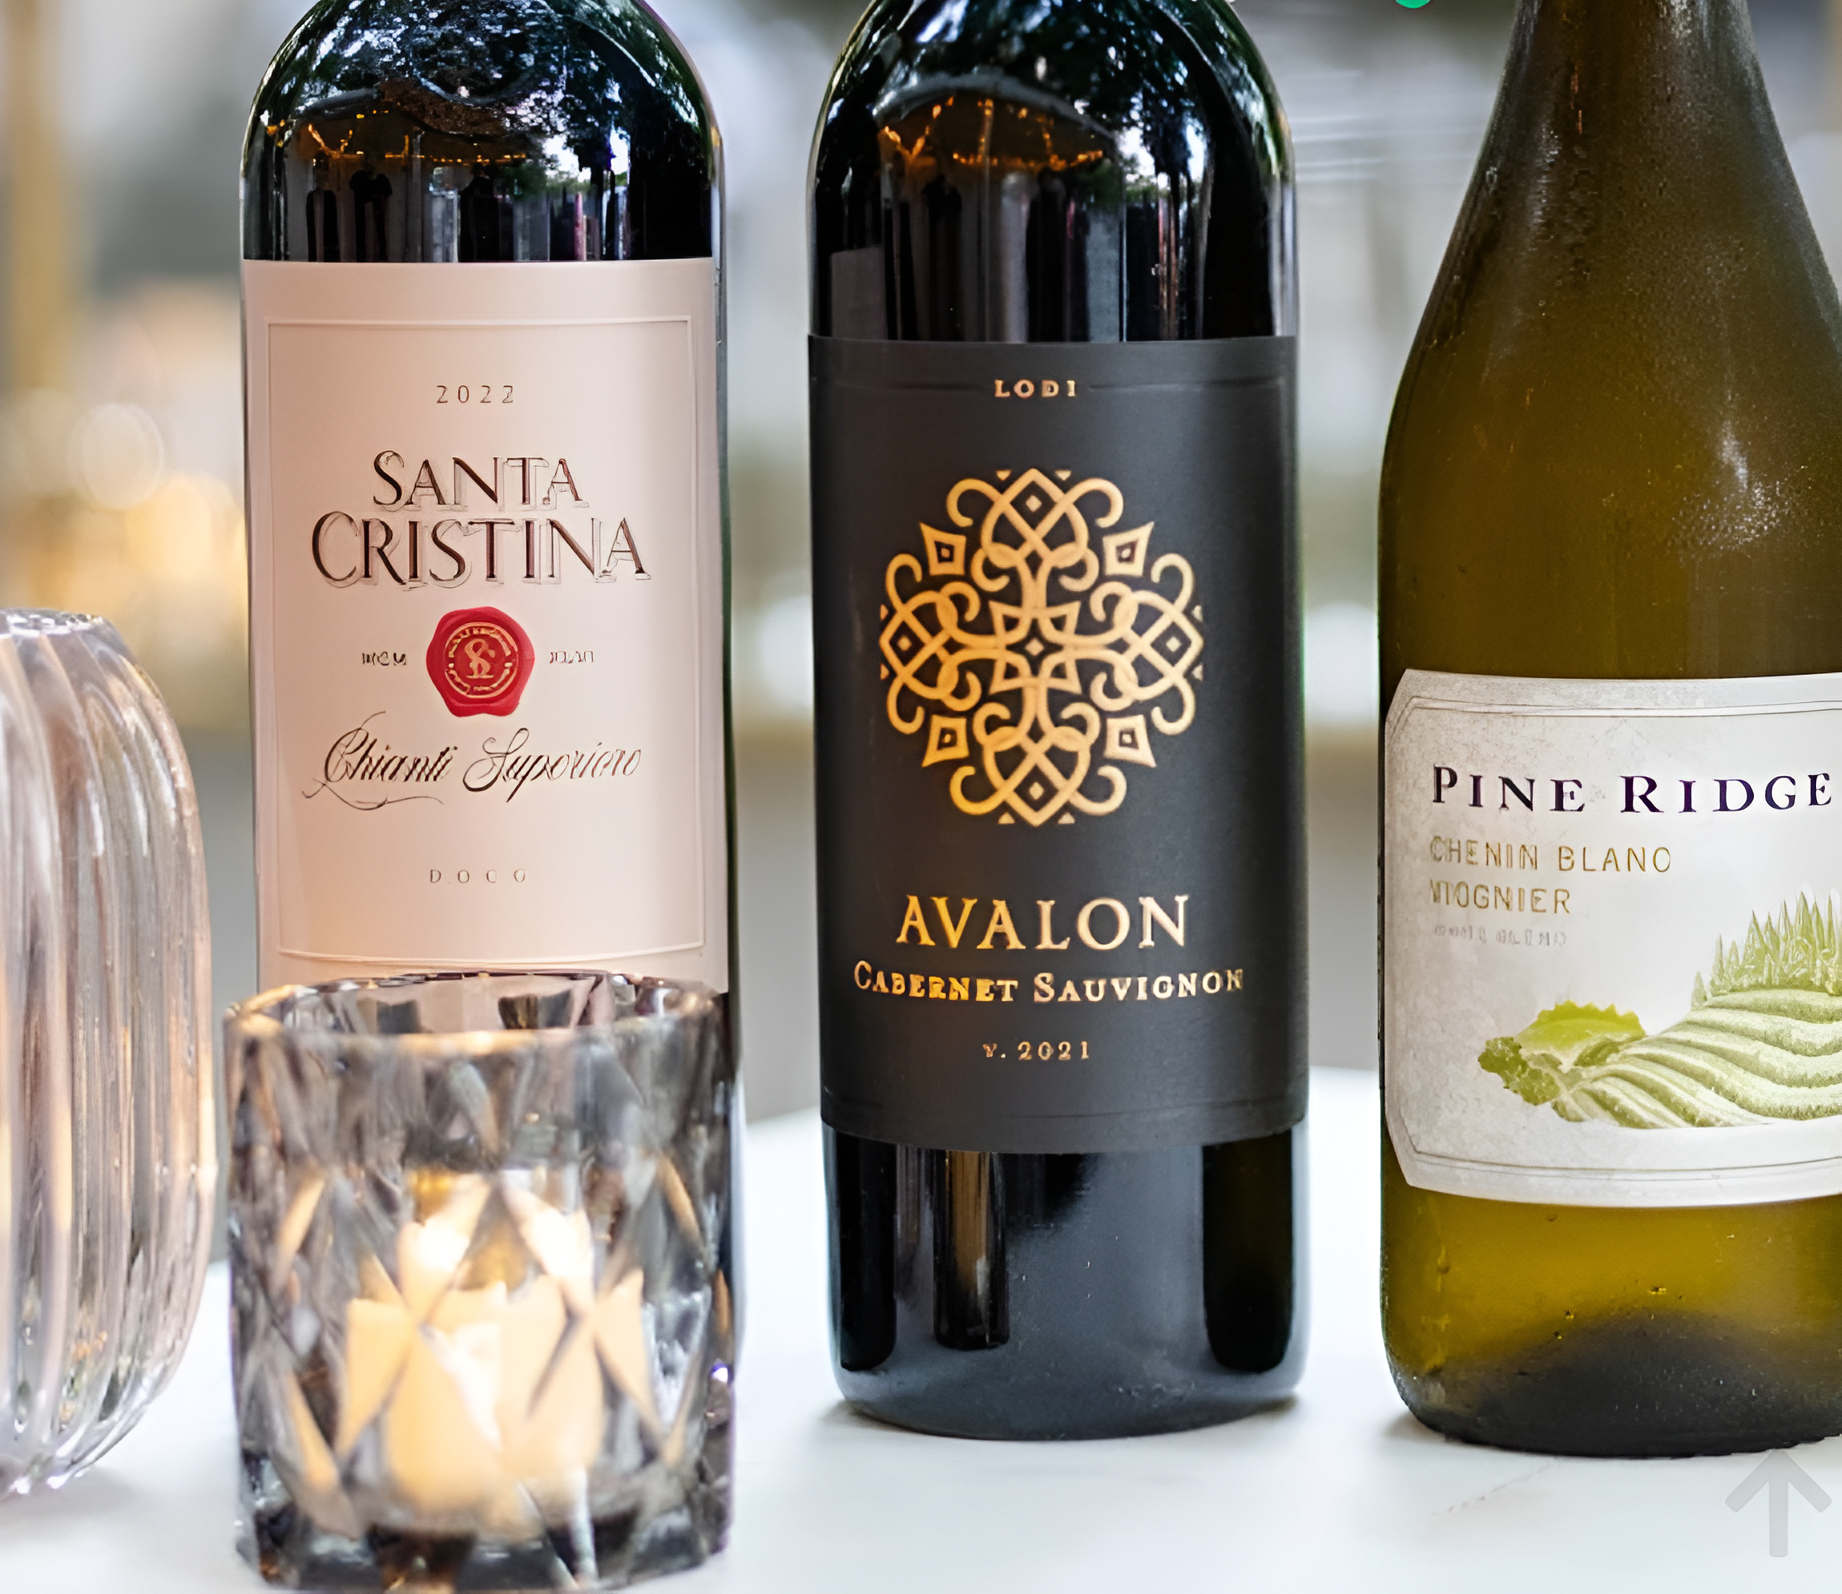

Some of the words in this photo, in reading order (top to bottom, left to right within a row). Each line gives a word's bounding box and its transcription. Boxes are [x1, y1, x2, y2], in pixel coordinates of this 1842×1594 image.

[436, 384, 514, 404] 2022
[994, 378, 1077, 399] LODI
[372, 449, 590, 511] SANTA
[310, 510, 652, 591] CRISTINA
[1432, 763, 1586, 813] PINE
[1619, 772, 1833, 814] RIDGE
[1430, 835, 1539, 871] CHENIN
[1430, 878, 1571, 914] VIOGNIER
[895, 894, 1190, 950] AVALON
[853, 959, 1019, 1002] CABERNET
[1033, 968, 1244, 1003] SAUVIGNON
[1017, 1041, 1089, 1060] 2021
